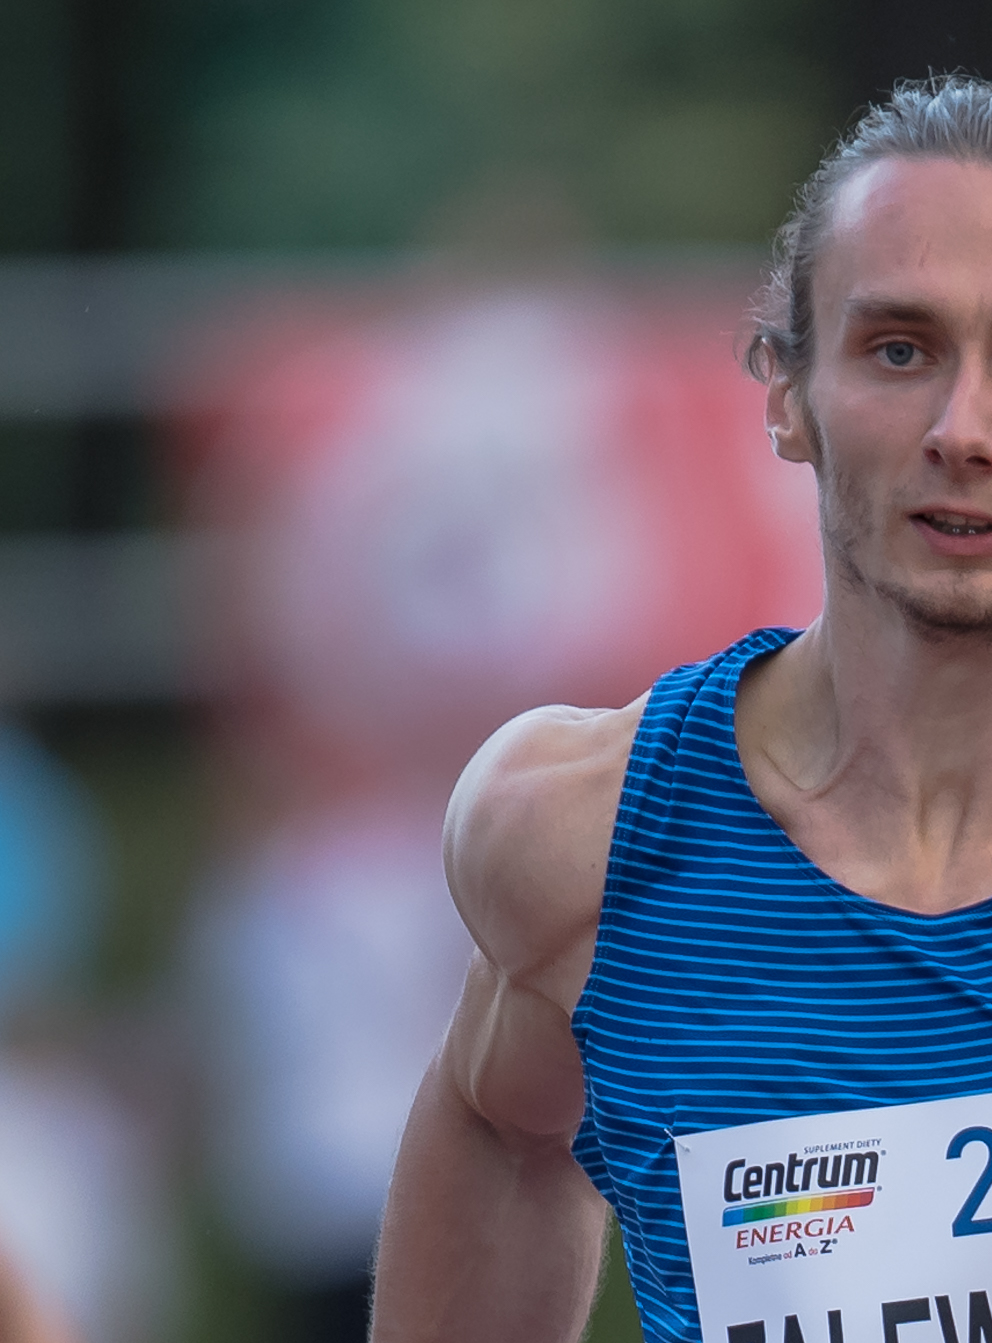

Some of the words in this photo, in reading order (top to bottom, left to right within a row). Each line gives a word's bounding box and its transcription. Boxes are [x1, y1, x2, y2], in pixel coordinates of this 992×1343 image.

[803, 1141, 855, 1155] SUPLEMENT
[856, 1138, 882, 1149] DIETY
[723, 1151, 880, 1204] Centrum
[736, 1215, 855, 1249] ENERGIA
[794, 1242, 807, 1258] A
